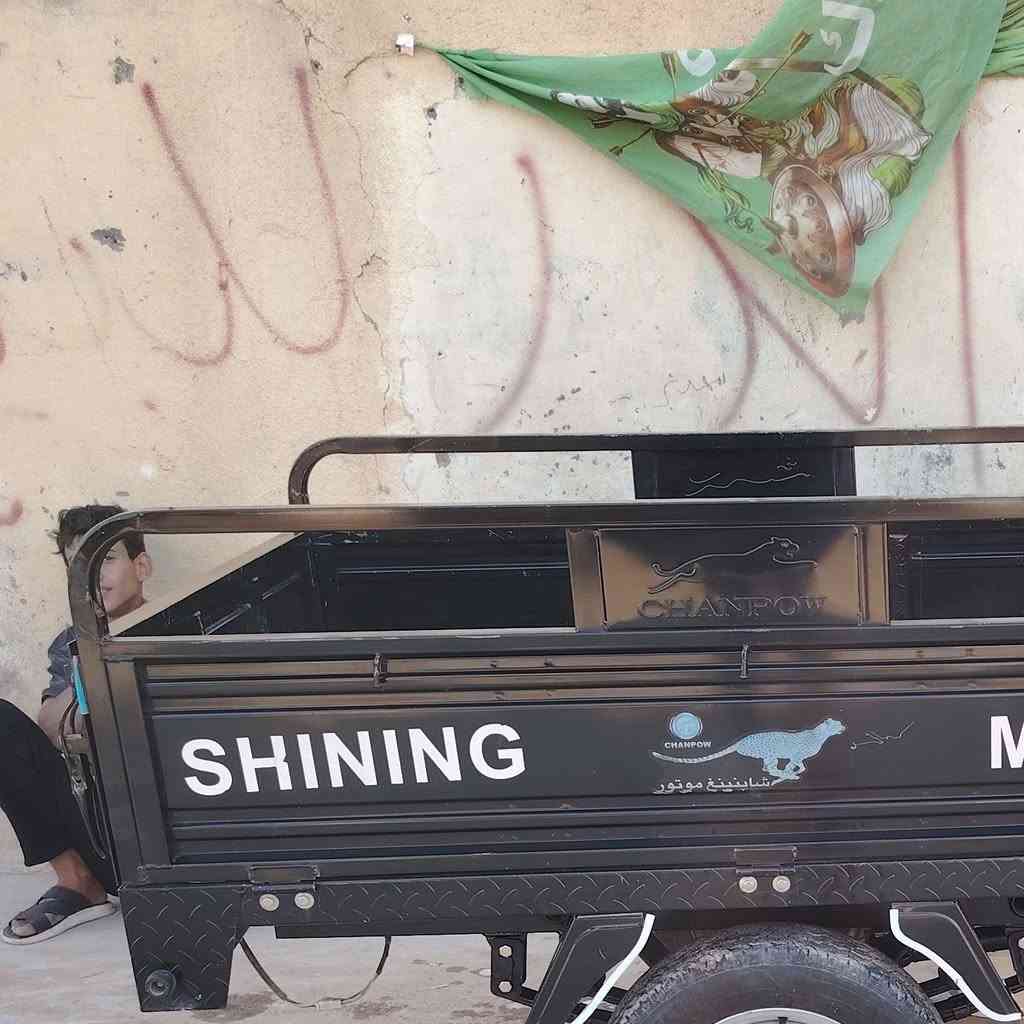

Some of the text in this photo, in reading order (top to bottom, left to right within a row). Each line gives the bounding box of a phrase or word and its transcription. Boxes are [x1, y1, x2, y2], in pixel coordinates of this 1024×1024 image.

[637, 594, 827, 619] CHANPOW
[664, 741, 712, 749] CHANPOW
[181, 723, 526, 797] SHINING
[652, 777, 703, 795] موتور
